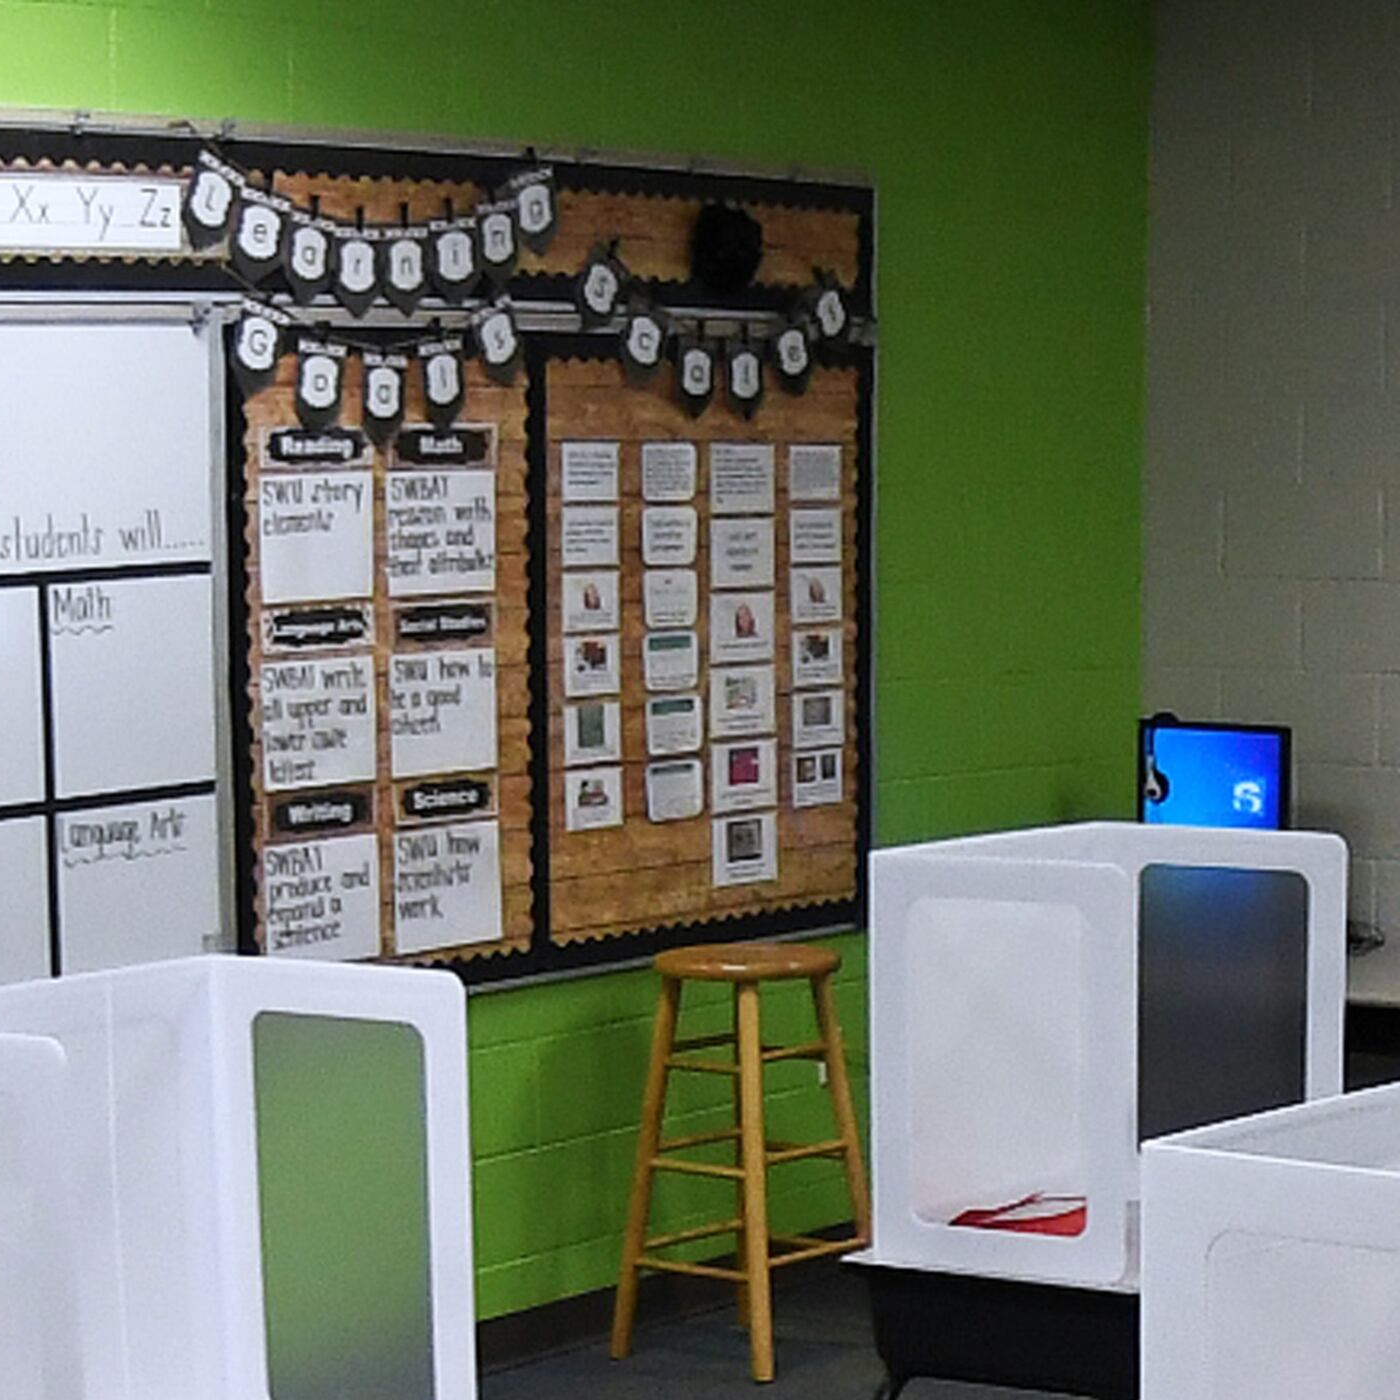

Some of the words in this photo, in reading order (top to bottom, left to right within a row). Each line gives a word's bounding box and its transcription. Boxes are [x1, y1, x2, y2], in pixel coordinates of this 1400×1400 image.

[9, 185, 50, 226] Xx
[78, 187, 114, 240] Yy
[139, 188, 173, 229] Zz
[0, 513, 104, 562] students
[53, 586, 112, 624] Math
